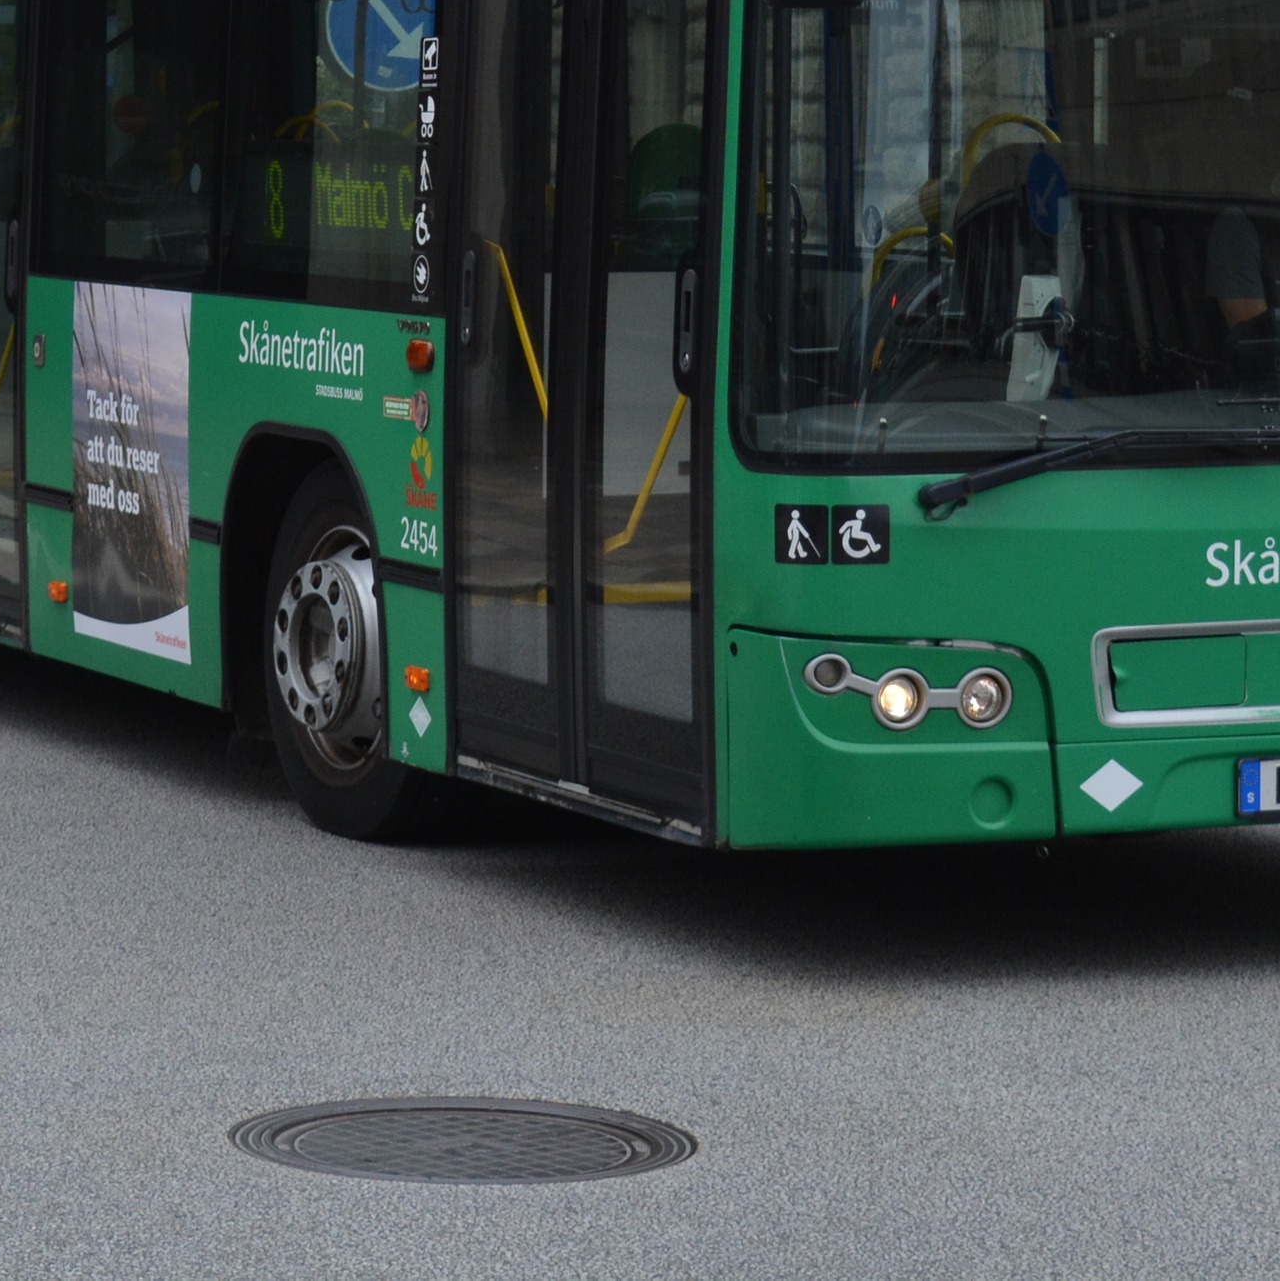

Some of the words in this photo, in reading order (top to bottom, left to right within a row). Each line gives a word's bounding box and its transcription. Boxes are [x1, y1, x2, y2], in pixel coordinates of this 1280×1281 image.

[269, 160, 285, 240] 8
[315, 162, 389, 230] Malmö
[397, 165, 415, 231] C
[238, 319, 365, 378] Skånetrafiken
[86, 389, 118, 423] Tack
[120, 393, 140, 427] för
[315, 384, 343, 399] STADSBUSS
[343, 387, 363, 402] MALMÖ
[86, 435, 105, 464] att
[107, 435, 124, 469] du
[126, 446, 160, 475] reser
[87, 479, 115, 510] med
[118, 489, 140, 516] oss
[401, 516, 438, 558] 2454
[1246, 791, 1255, 804] S
